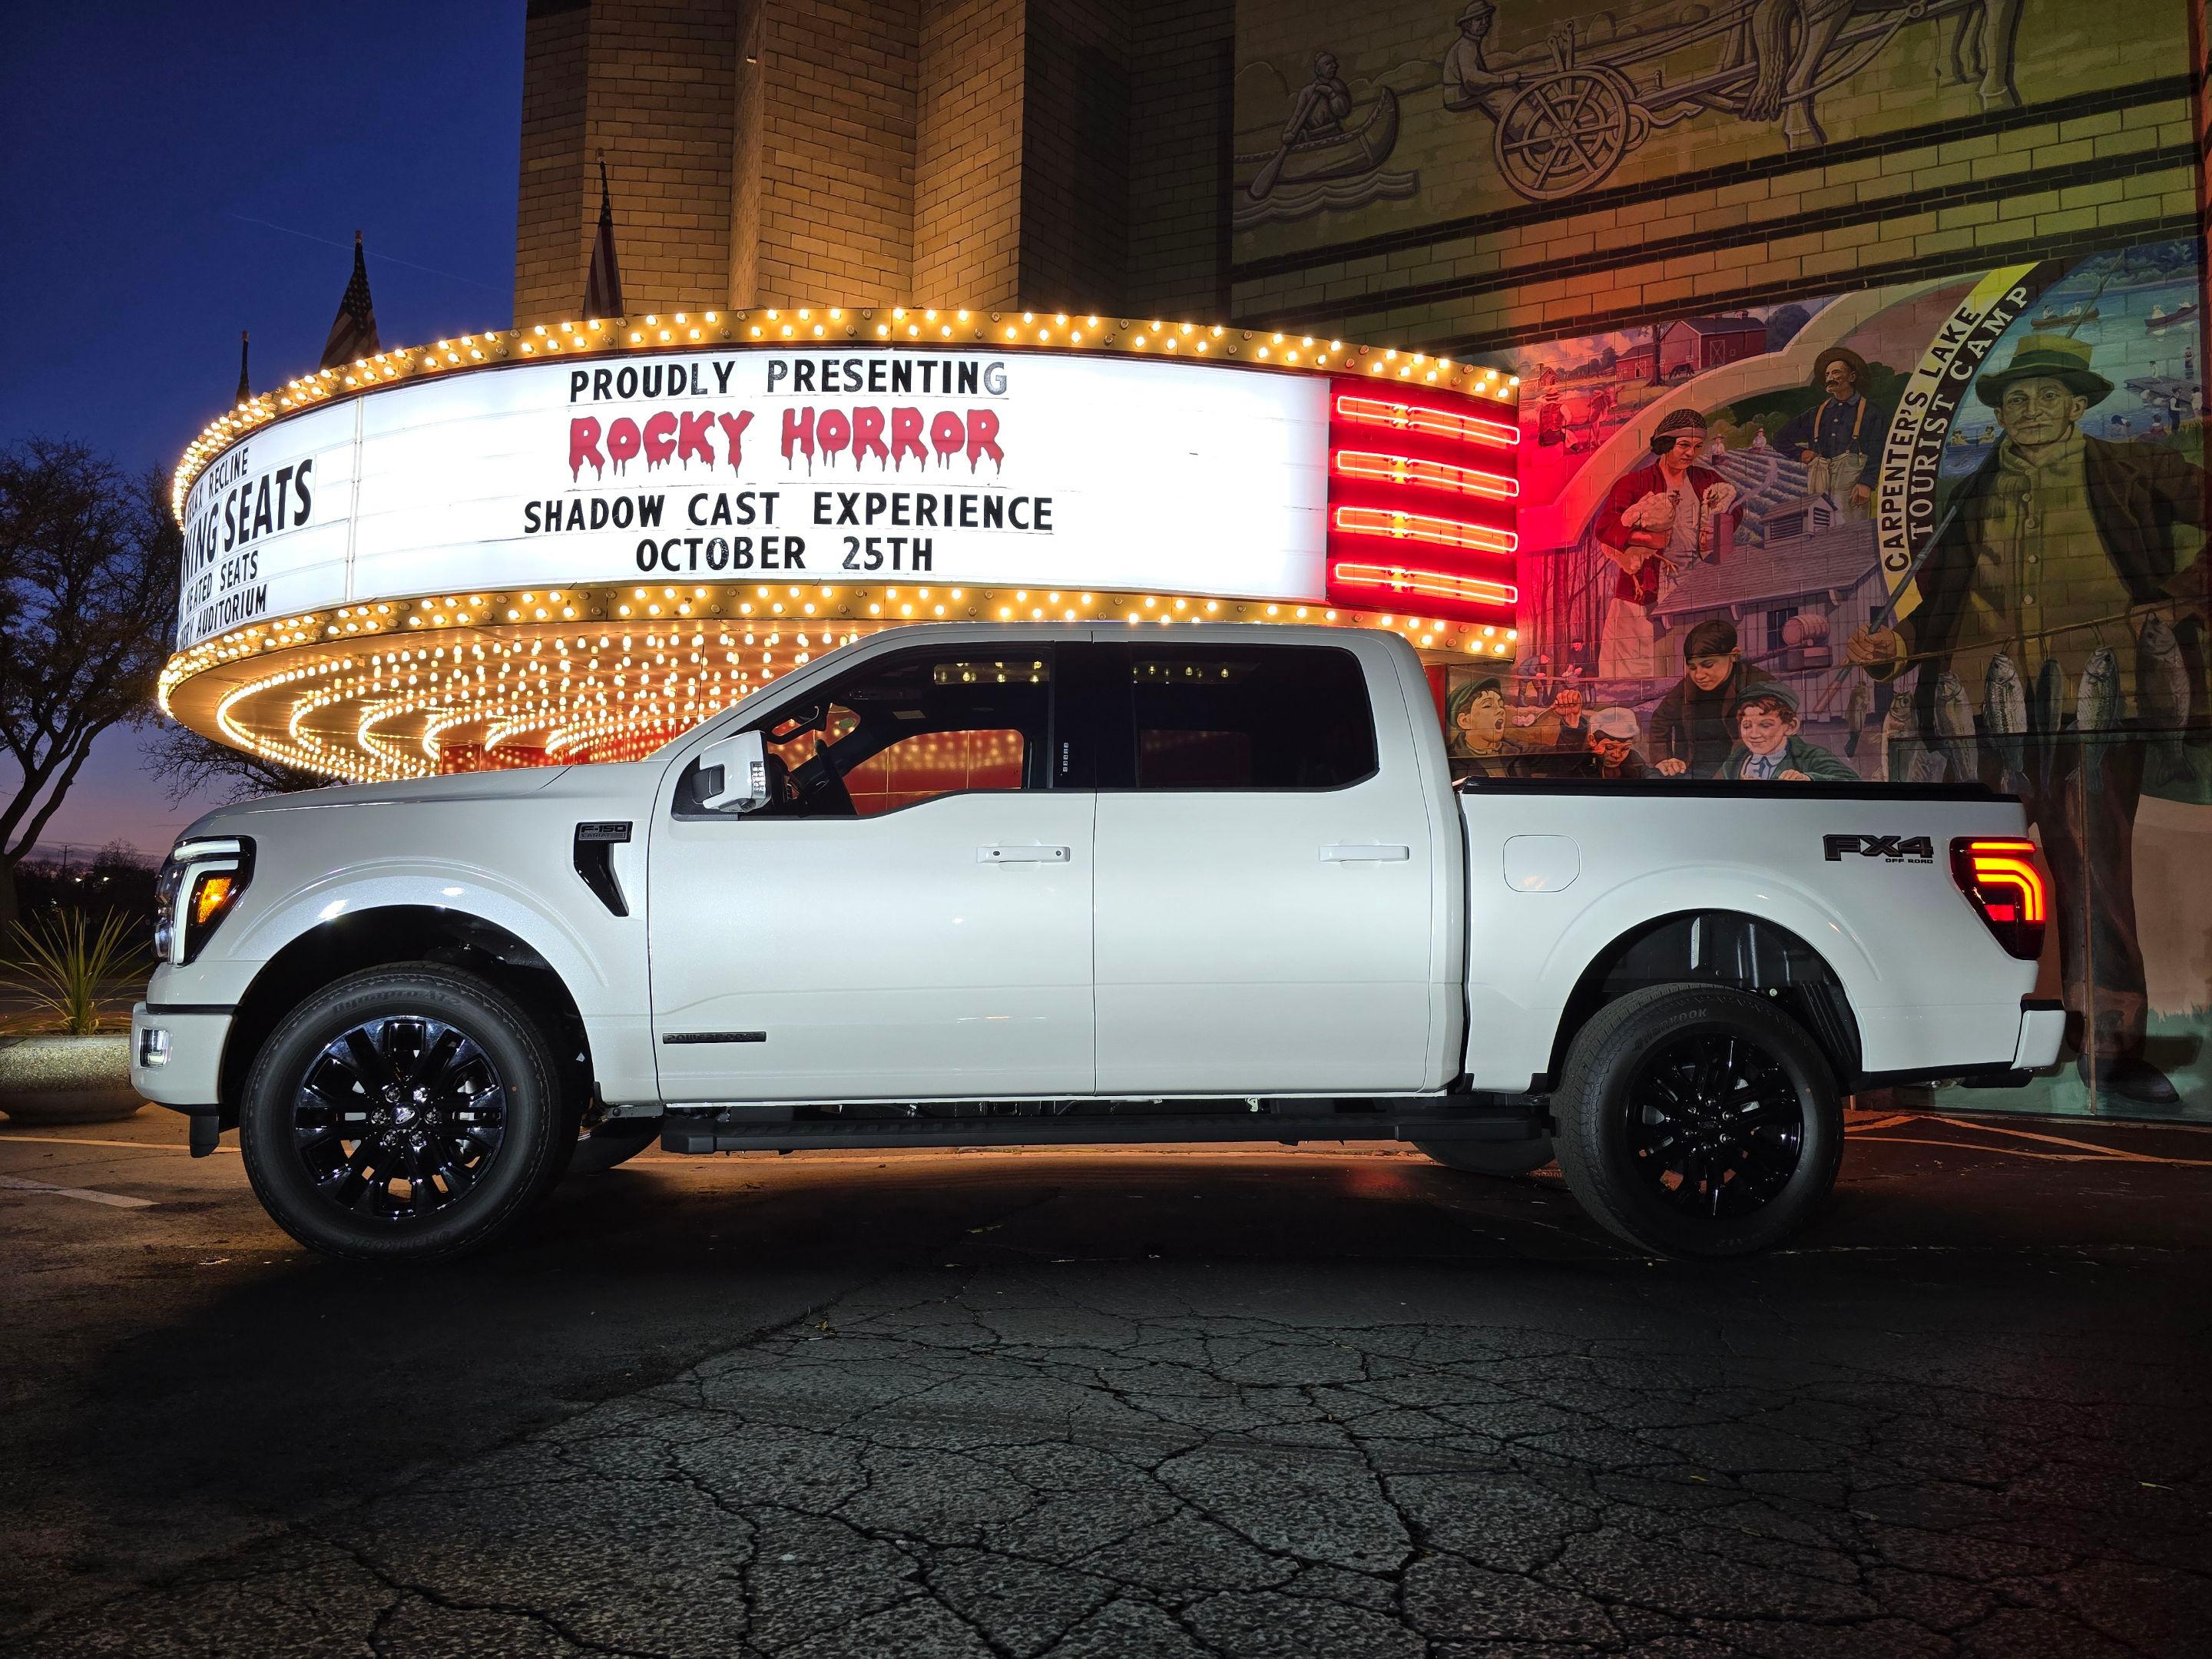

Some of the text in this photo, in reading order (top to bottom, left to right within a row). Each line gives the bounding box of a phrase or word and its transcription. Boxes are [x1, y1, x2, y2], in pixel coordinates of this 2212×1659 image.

[570, 359, 1008, 402] PROUDLY PRESENTING
[1881, 307, 1982, 572] CARPENTER'S LAKE
[1909, 286, 2028, 540] TOURIST CAMP
[568, 406, 1005, 483] ROCKY HORROR
[209, 446, 249, 499] RECLINE
[224, 459, 313, 552] SEATS
[524, 492, 1053, 534] SHADOW CAST EXPERIENCE
[187, 549, 259, 608] HEATED SEATS
[635, 536, 933, 572] OCTOBER 25TH
[197, 584, 268, 638] AUDITORIUM
[1823, 834, 1934, 861] FX4
